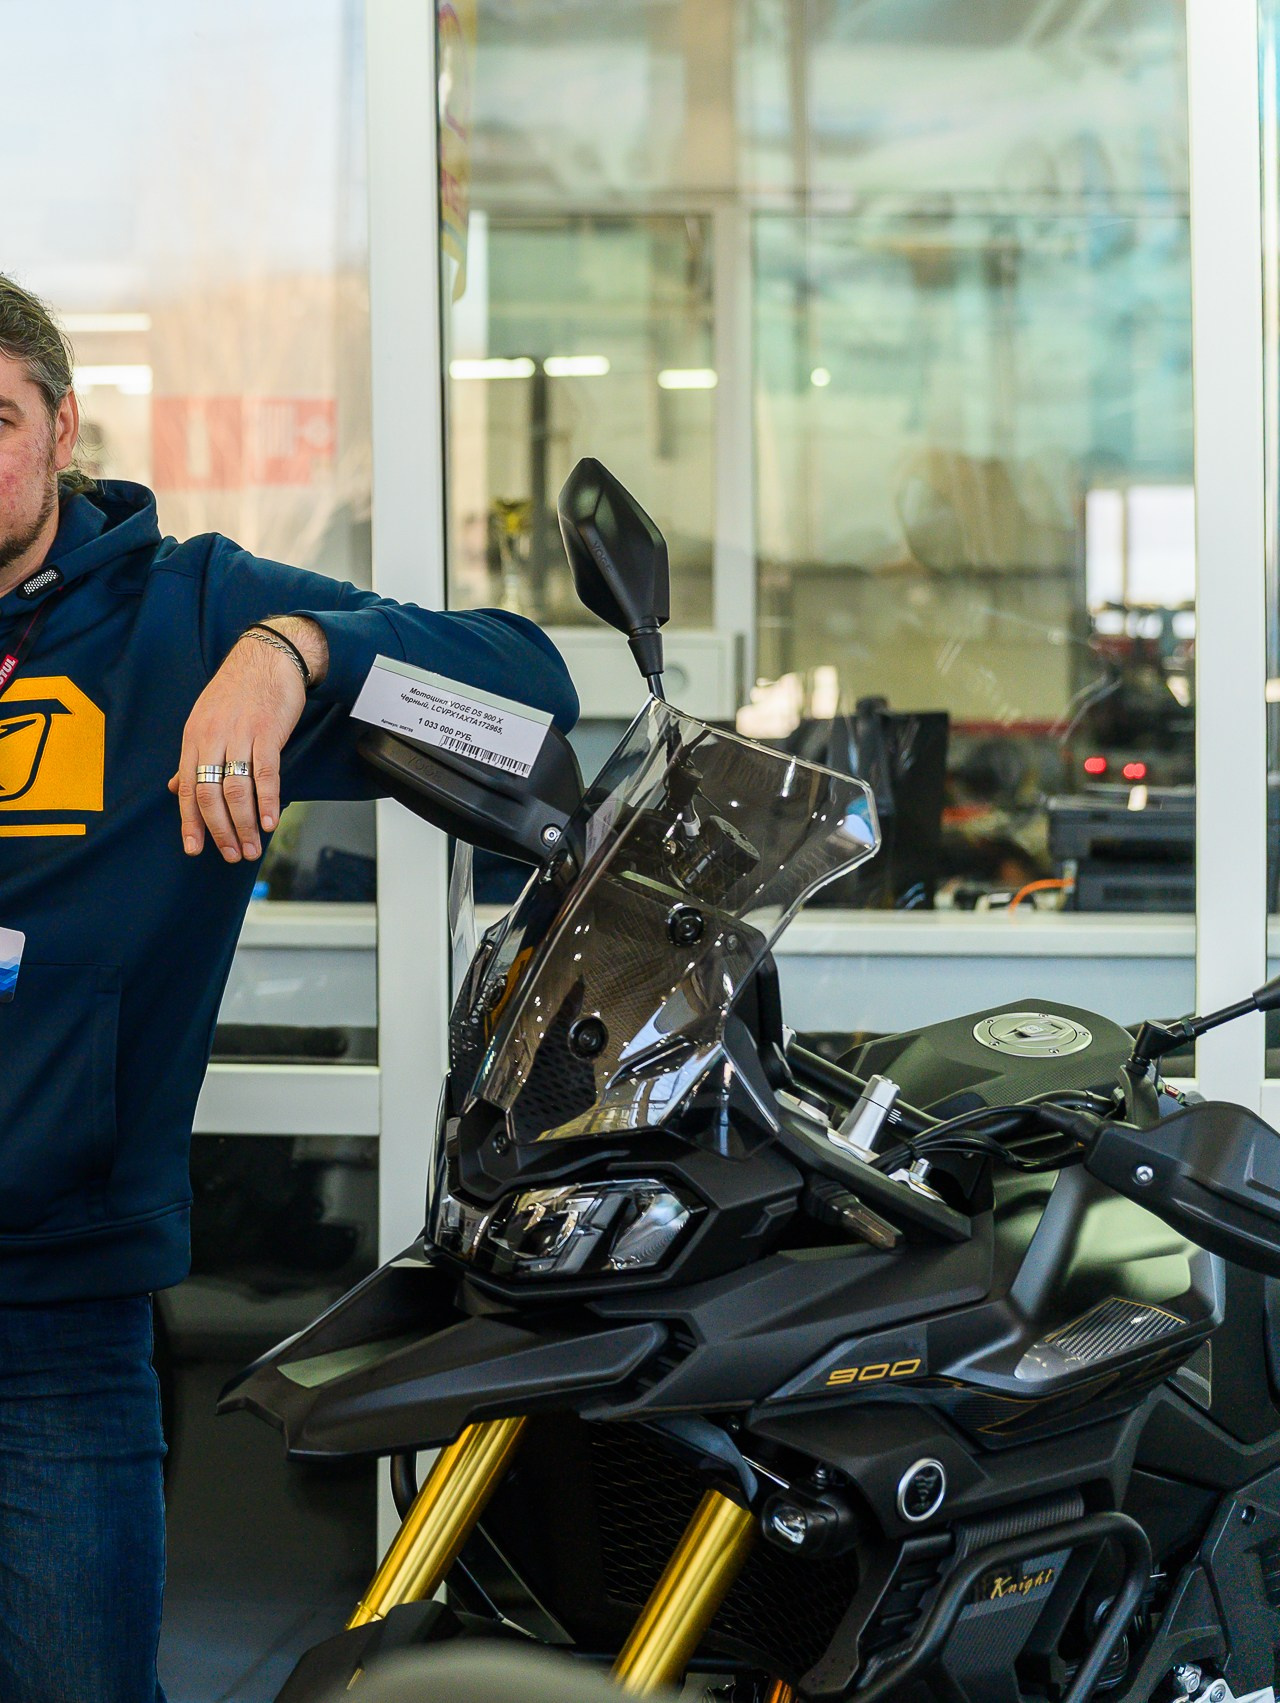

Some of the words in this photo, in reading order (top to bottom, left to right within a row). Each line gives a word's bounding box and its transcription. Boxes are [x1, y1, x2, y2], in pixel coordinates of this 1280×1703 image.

[400, 693, 429, 709] Черный,
[409, 687, 449, 705] Мотоцикл
[471, 708, 483, 717] DS
[484, 712, 497, 722] 900
[418, 717, 423, 725] 1
[424, 719, 439, 730] 033
[439, 725, 454, 735] 000
[455, 730, 473, 743] РУБ.
[826, 1358, 922, 1386] 900
[990, 1568, 1054, 1600] Knight
